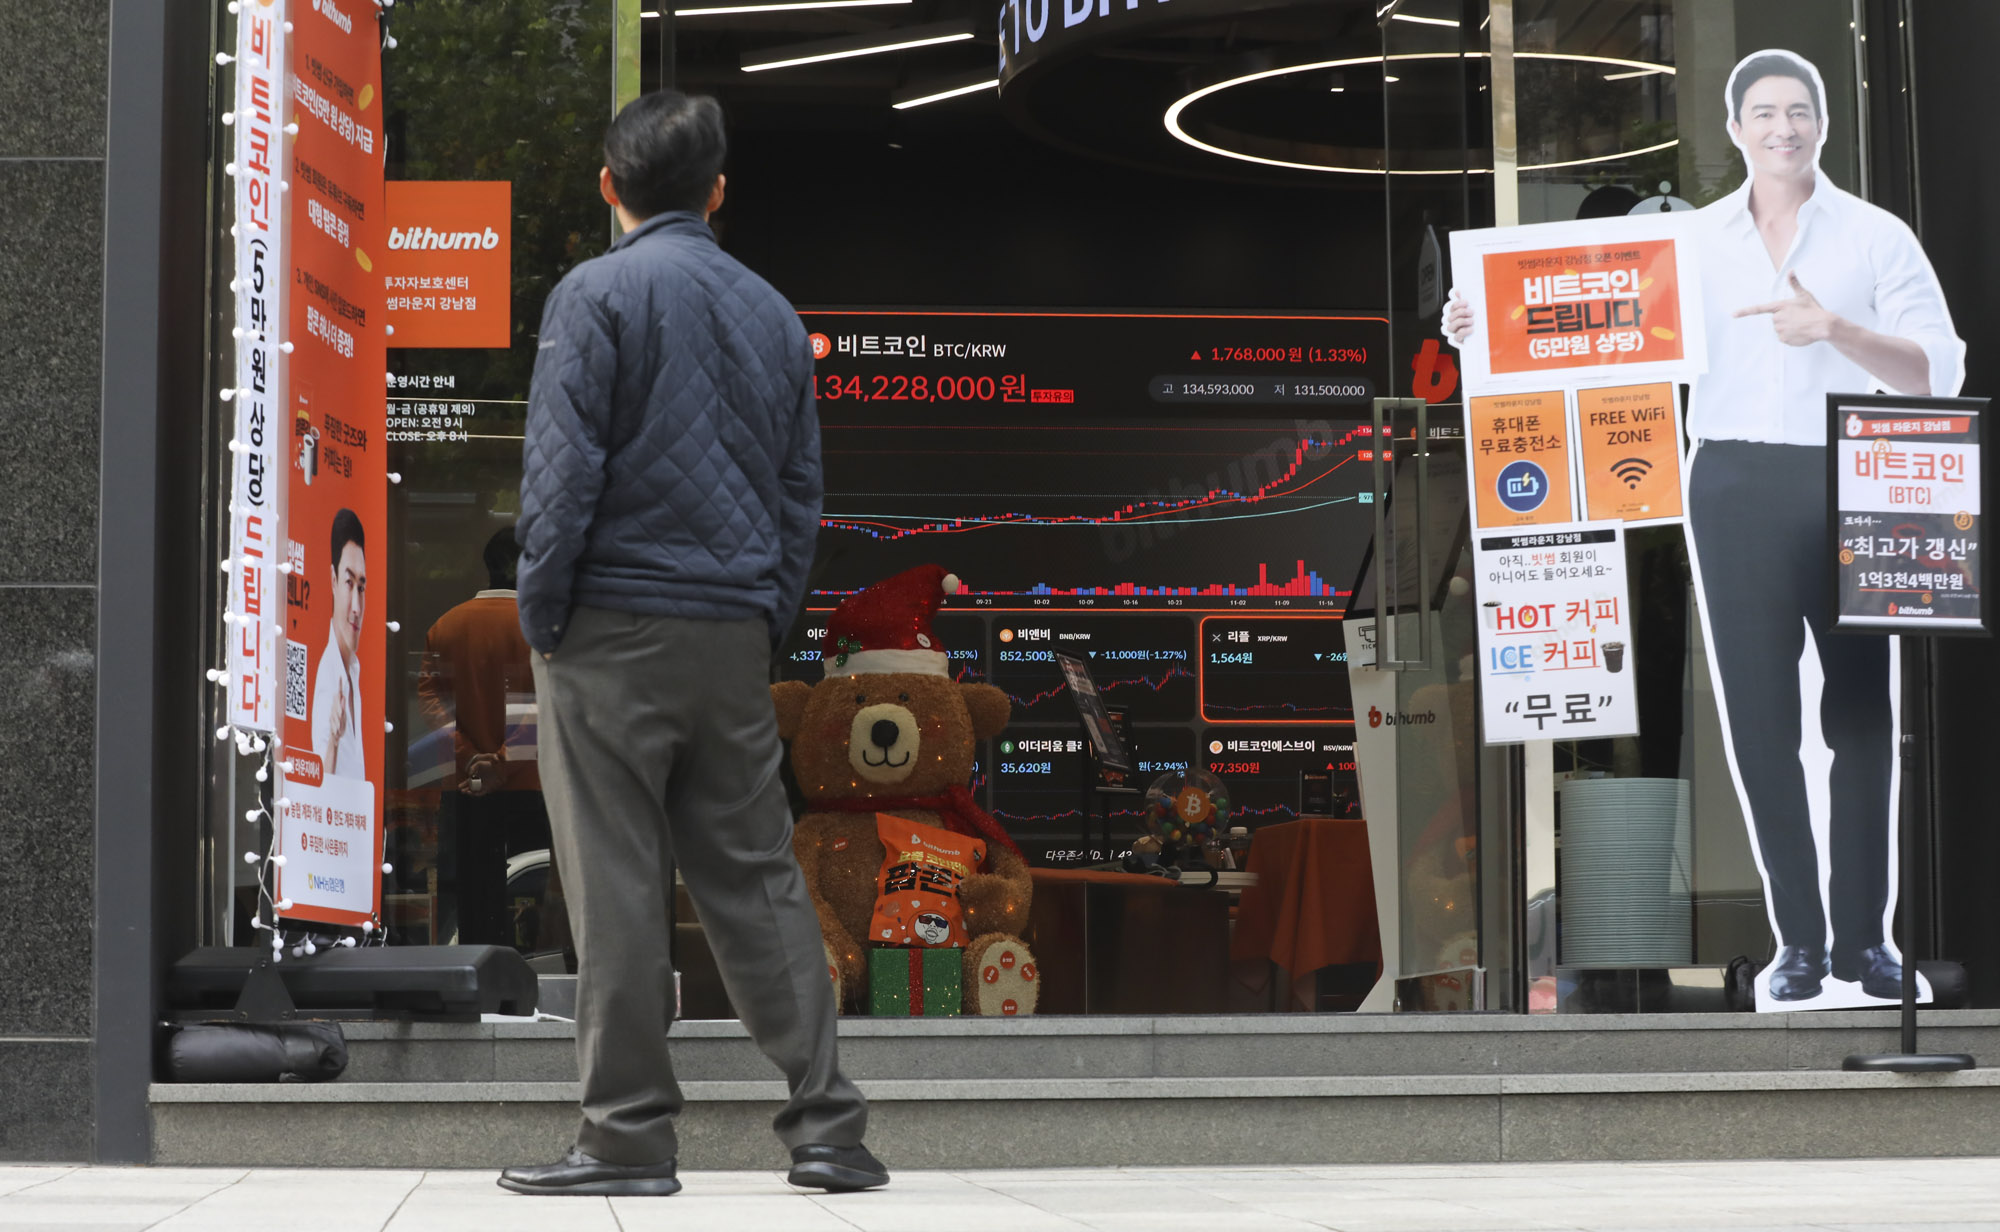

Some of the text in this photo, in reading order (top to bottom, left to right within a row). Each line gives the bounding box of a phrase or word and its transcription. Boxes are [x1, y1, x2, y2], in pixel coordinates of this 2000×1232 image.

[249, 15, 271, 231] 비트코인
[295, 77, 329, 125] 트코인(5만
[356, 124, 373, 154] 지급
[308, 198, 322, 229] 대형
[323, 208, 336, 239] 팝콘
[387, 226, 498, 250] bithumb
[1565, 252, 1592, 266] 강남점
[1595, 252, 1612, 264] 오픈
[1615, 250, 1641, 262] 이벤트
[385, 276, 469, 290] 투자자보호센터
[1523, 268, 1640, 305] 비트코인
[386, 296, 476, 310] 썸라운지 강남점
[307, 305, 319, 336] 팝콘
[1527, 299, 1643, 335] 드립니다
[838, 334, 1007, 360] 비트코인 BTC/KRW
[1529, 331, 1644, 359] (5만원 상당)
[1308, 347, 1367, 364] (1.33%)
[433, 376, 455, 388] 안내
[1163, 384, 1365, 397] 고 134,593,000 저 131,500,000
[386, 403, 475, 416] 월-금 (공휴일 제외)
[1590, 406, 1666, 427] FREE WiFi
[386, 417, 419, 428] OPEN:
[421, 417, 441, 428] 오전
[1492, 415, 1541, 434] 휴대폰
[386, 431, 424, 442] CLOSE:
[426, 430, 446, 442] 오후
[1607, 428, 1652, 446] ZONE
[248, 402, 265, 506] 상당)
[1480, 435, 1562, 456] 무료충전소
[1855, 451, 1964, 483] 비트코인
[1511, 533, 1582, 547] 빗썸라운지 강남점
[1560, 549, 1597, 564] 회원이
[1490, 568, 1539, 585] 아니어도
[1858, 571, 1964, 591] 1억3천4백만원
[242, 514, 264, 722] 드립니다
[1496, 596, 1619, 630] HOT 커피
[1898, 606, 1934, 616] bithumb
[1017, 628, 1091, 641] 비앤비 BNB/KRW
[1228, 631, 1288, 643] 리플 XRP/KRW
[1210, 652, 1253, 665] 1,564원
[1491, 638, 1597, 671] ICE 커피
[1386, 710, 1435, 726] bihumb
[1019, 741, 1063, 753] 이더리움
[1227, 740, 1315, 753] 비트코인에스브이
[1001, 762, 1051, 774] 35,620원
[1210, 762, 1260, 774] 97,350원
[1338, 762, 1356, 771] 100
